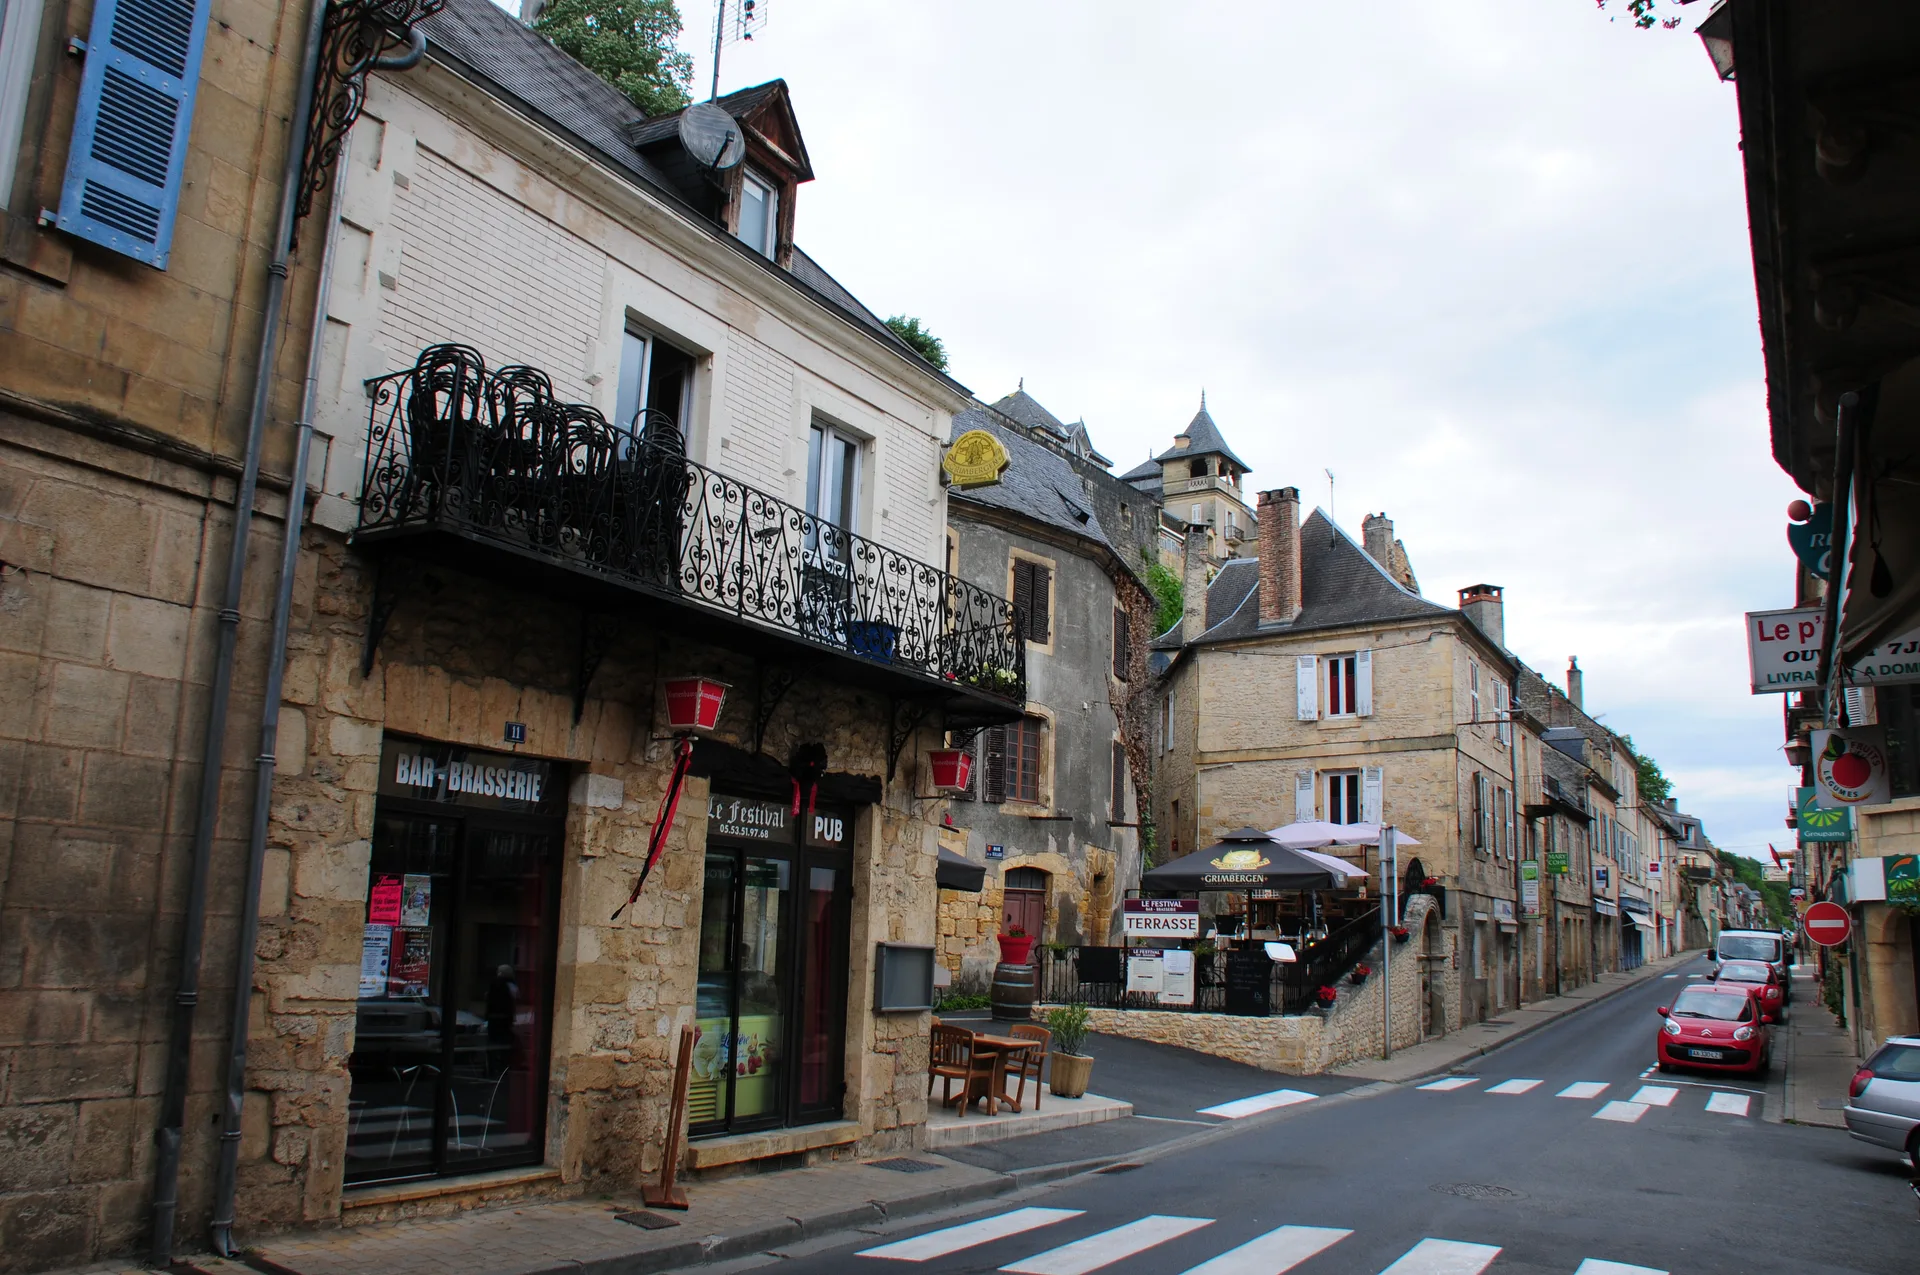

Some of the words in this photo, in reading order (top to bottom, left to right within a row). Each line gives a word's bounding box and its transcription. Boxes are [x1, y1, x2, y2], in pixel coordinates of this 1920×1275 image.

[1758, 620, 1790, 641] Le
[1798, 615, 1824, 645] p'
[1880, 663, 1920, 676] DOM
[511, 725, 520, 739] 11
[1850, 740, 1881, 767] FRUITS
[396, 753, 434, 788] BAR
[448, 761, 541, 803] BRASSERIE
[707, 796, 723, 819] Le
[727, 800, 784, 828] Festival
[719, 823, 769, 839] 05.53.51.97.68
[814, 816, 843, 842] PUB
[1804, 830, 1845, 838] Groupama
[1204, 874, 1264, 883] GRIMBERGEN
[1126, 917, 1196, 930] TERRASSE
